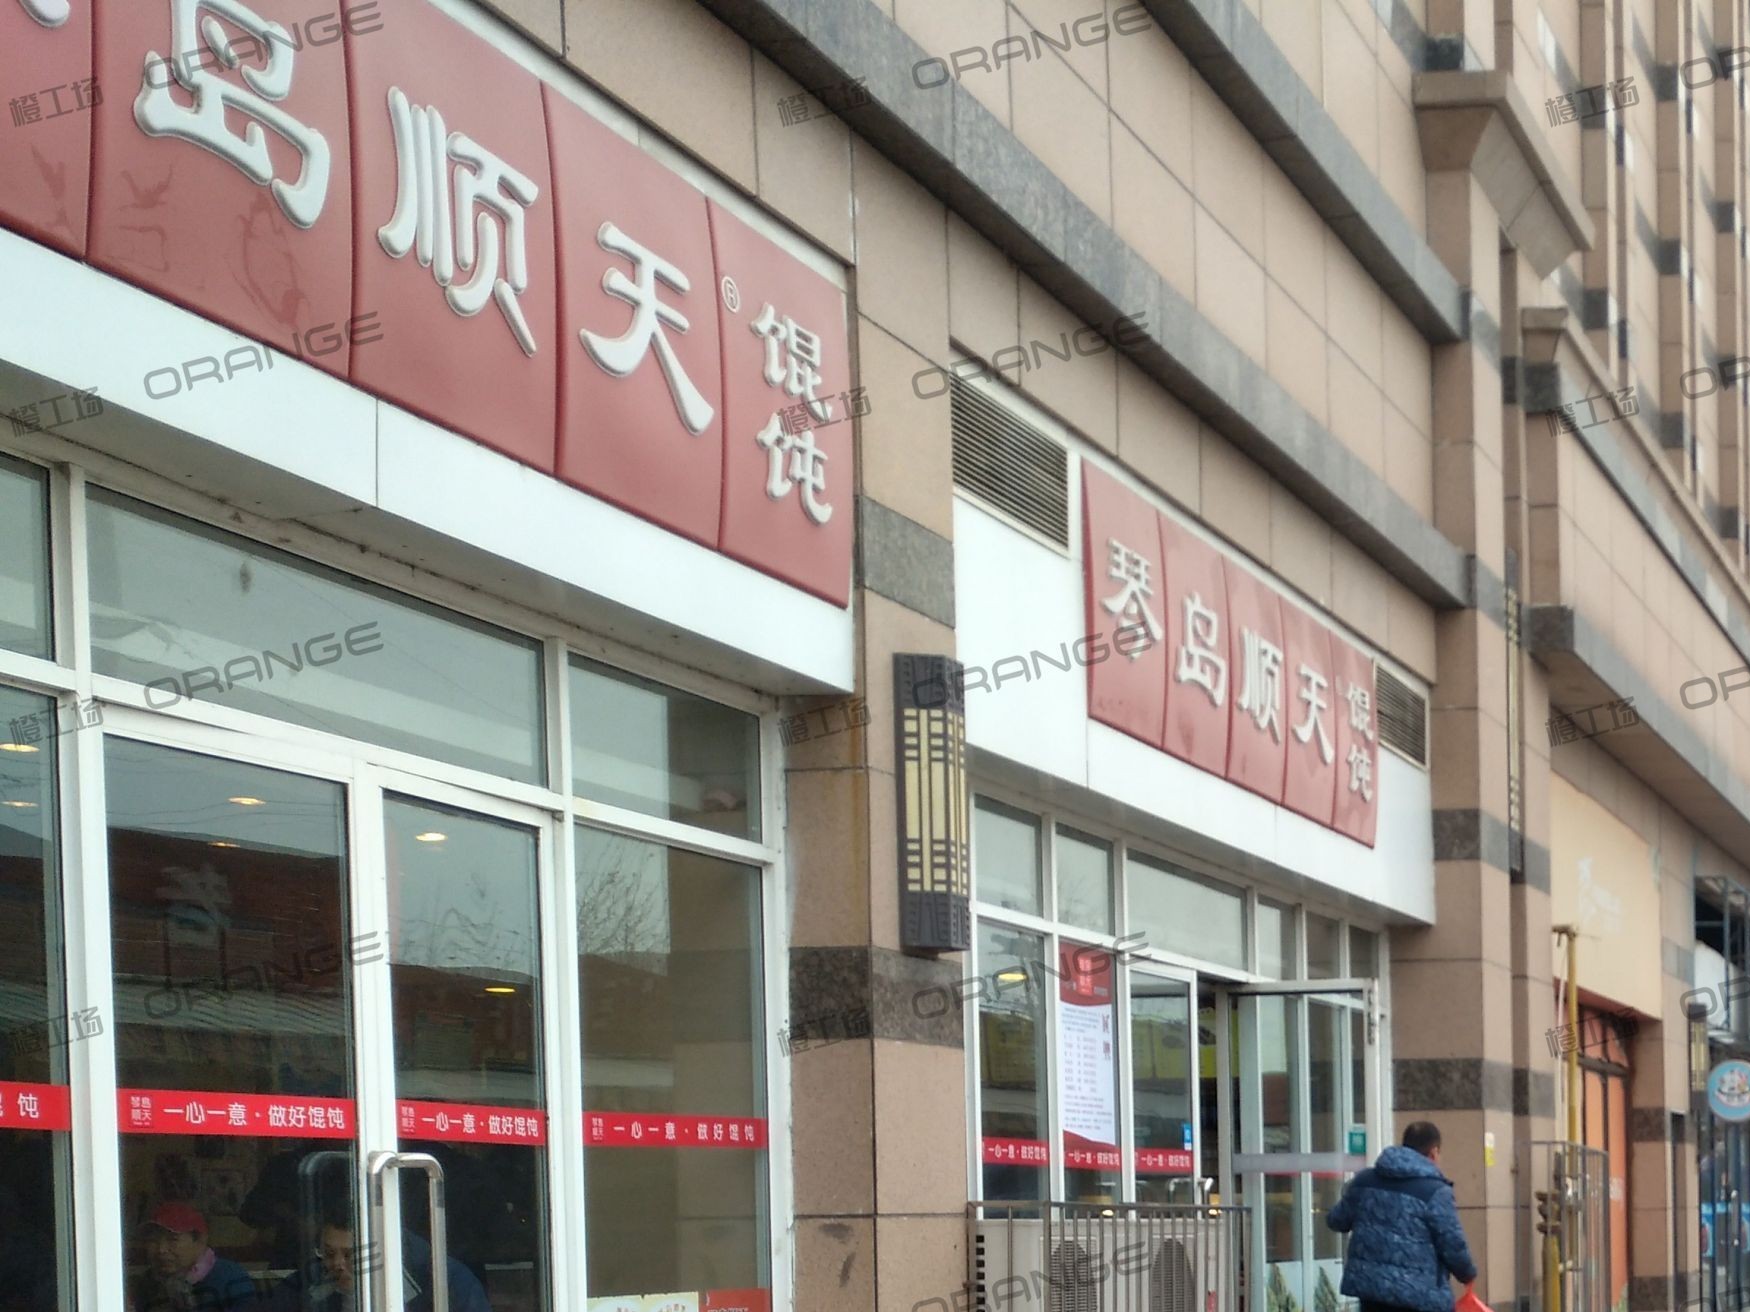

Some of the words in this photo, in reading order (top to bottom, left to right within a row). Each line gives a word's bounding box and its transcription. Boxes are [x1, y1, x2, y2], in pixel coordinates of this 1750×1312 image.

[24, 0, 714, 436] 岛顺天
[750, 302, 833, 525] 馄饨
[1101, 537, 1335, 766] 琴岛顺天
